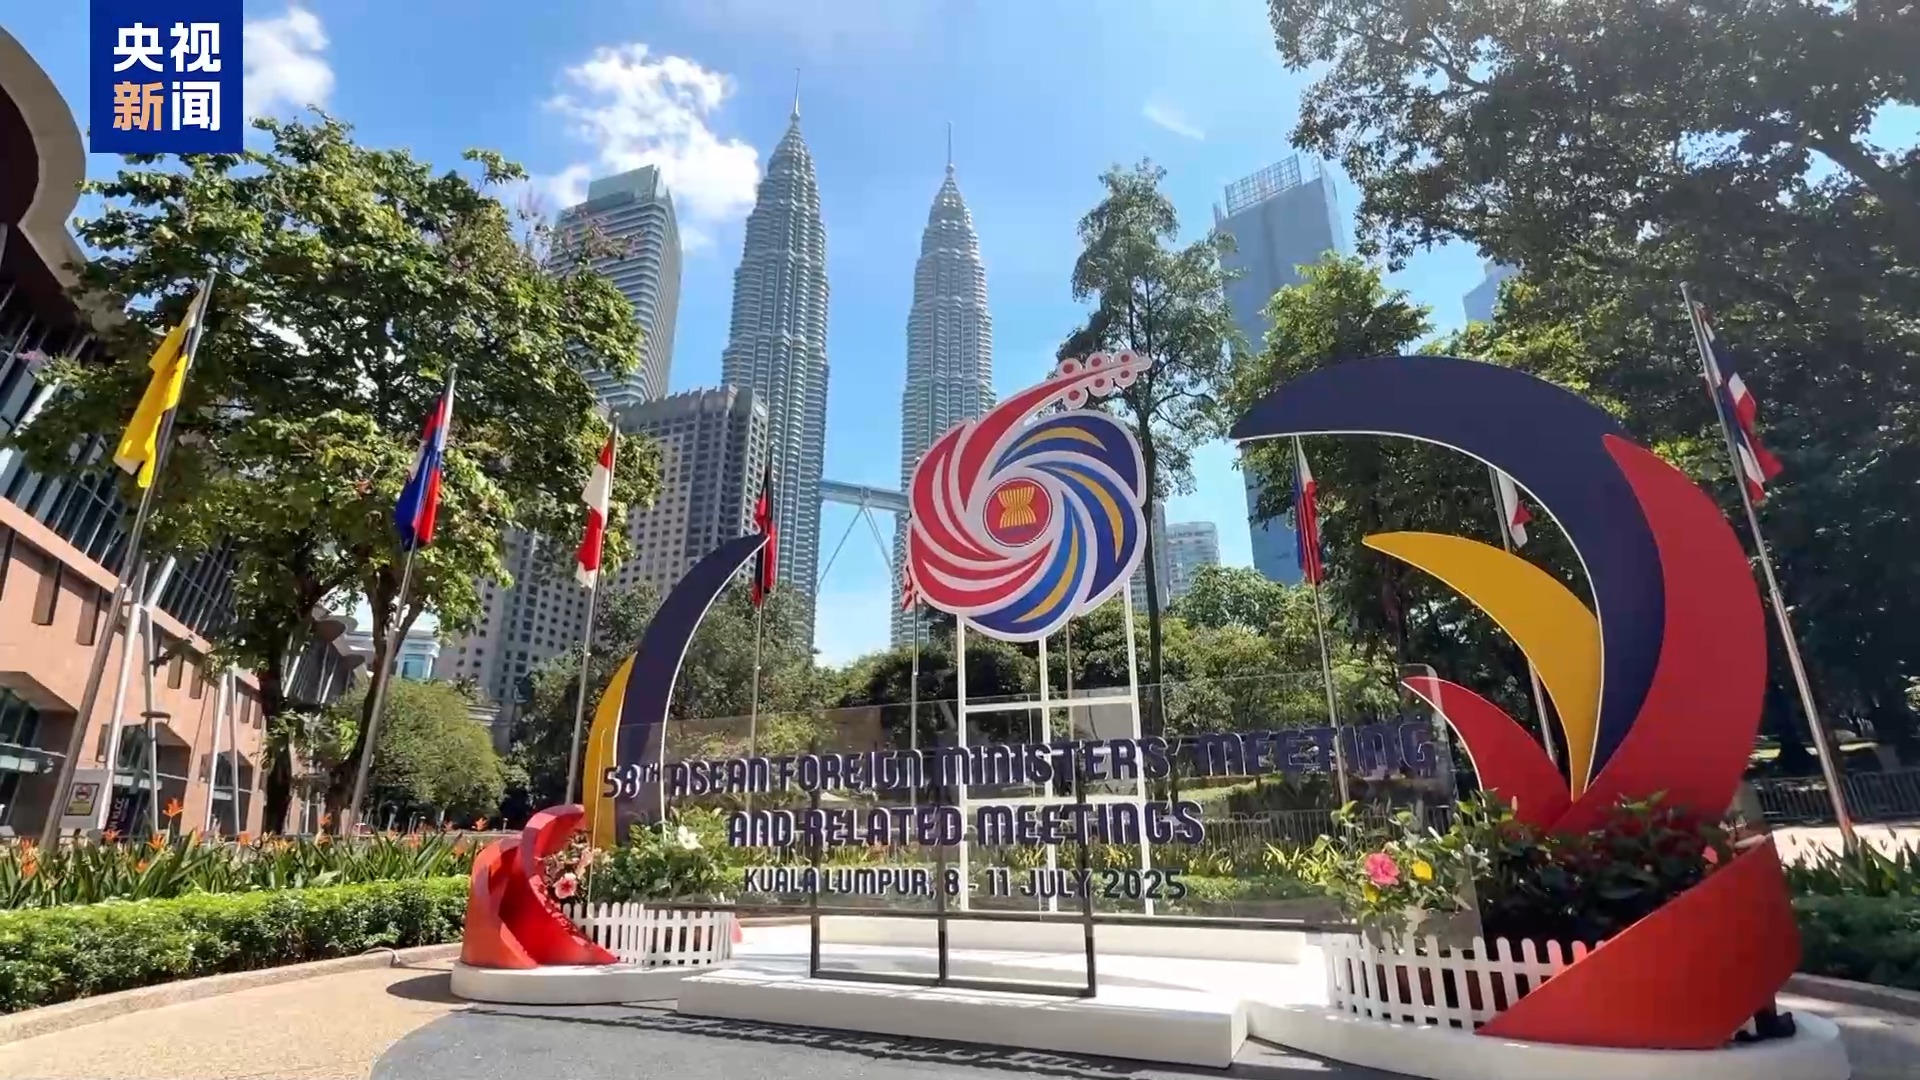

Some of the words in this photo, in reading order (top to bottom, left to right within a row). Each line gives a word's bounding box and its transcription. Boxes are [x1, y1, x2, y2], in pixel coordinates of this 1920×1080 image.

[602, 763, 660, 799] 58TH
[671, 757, 770, 796] ASEAN
[780, 749, 924, 791] FOREIGN
[1198, 722, 1438, 777] MEETING
[730, 810, 794, 847] AND
[804, 806, 963, 847] RELATED
[977, 800, 1204, 846] MEETINGS
[744, 866, 820, 894] KUALA
[826, 867, 937, 899] LUMPUR,
[944, 868, 960, 896] 8
[987, 867, 1011, 897] 11
[1020, 869, 1092, 899] JULY
[1104, 869, 1187, 900] 2025
